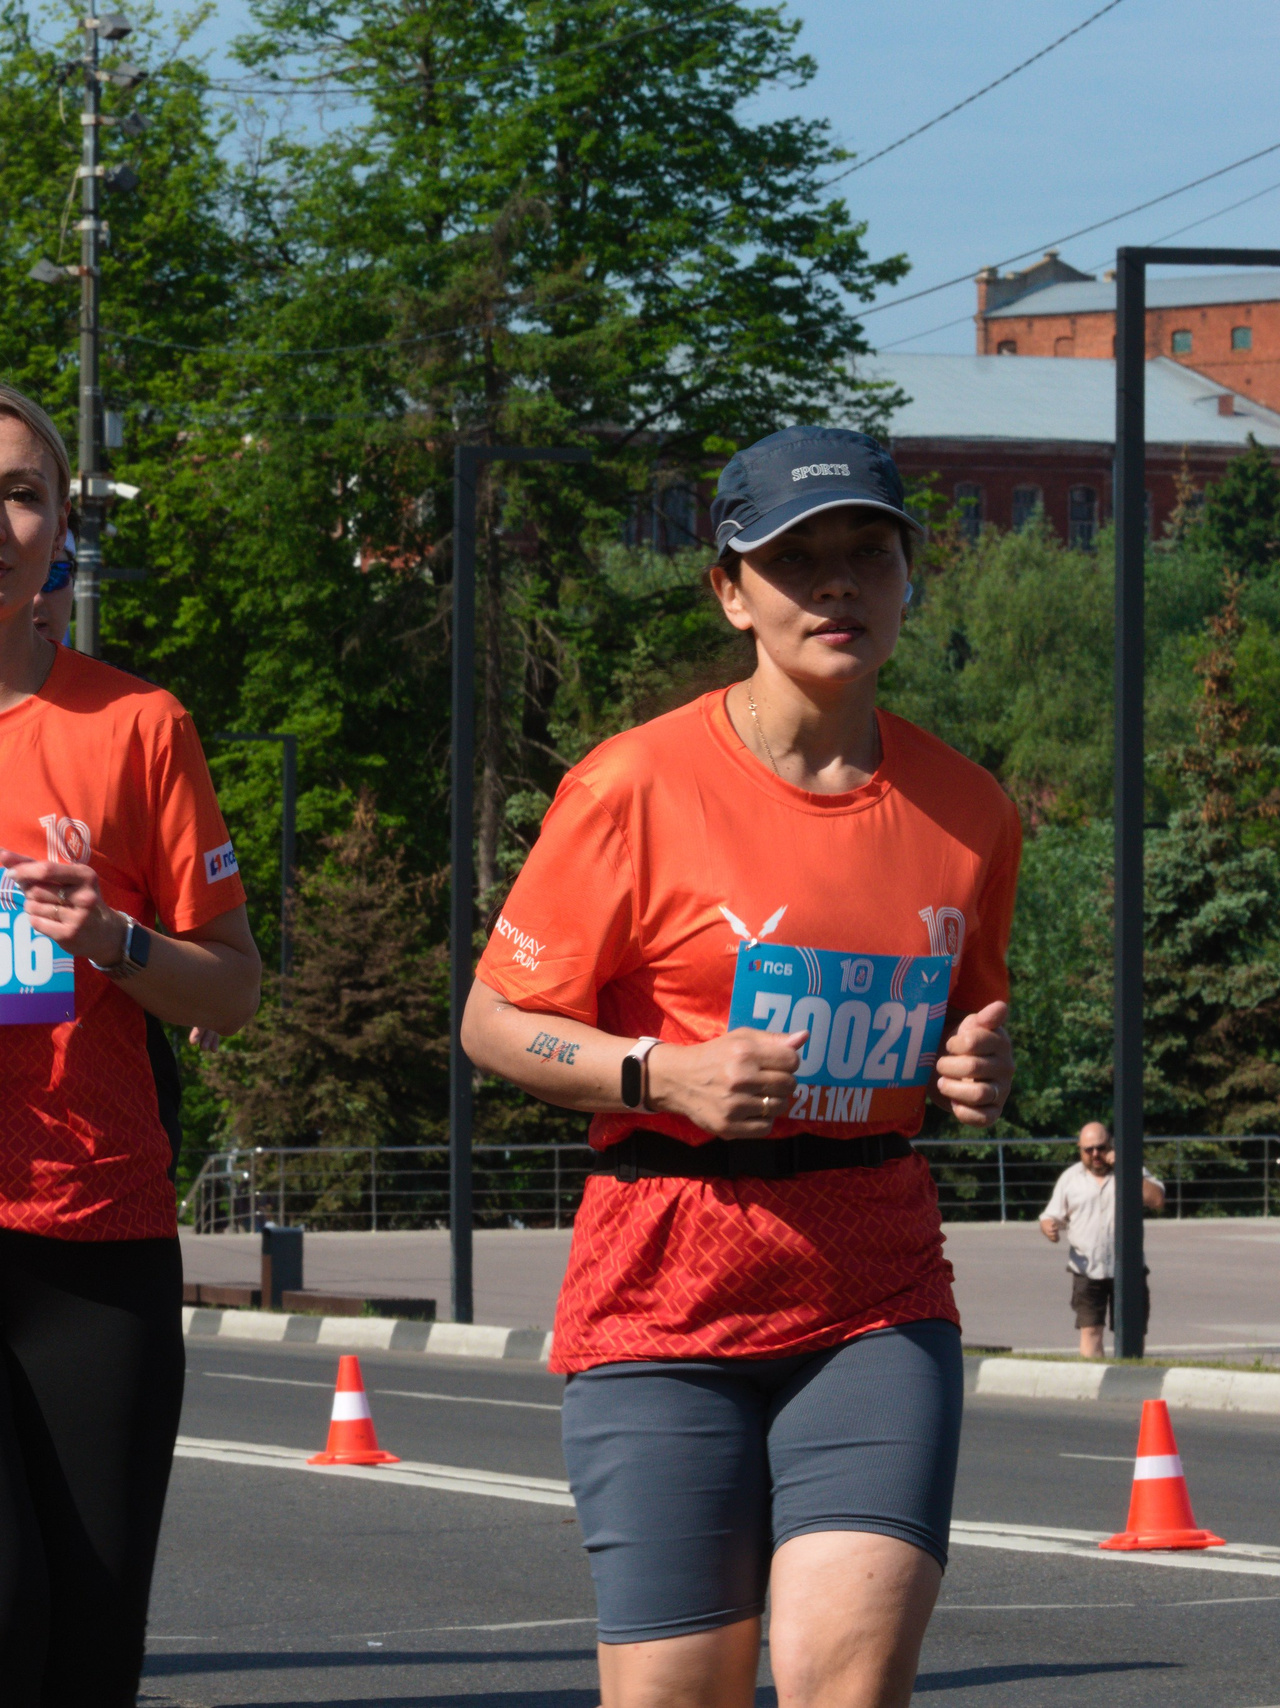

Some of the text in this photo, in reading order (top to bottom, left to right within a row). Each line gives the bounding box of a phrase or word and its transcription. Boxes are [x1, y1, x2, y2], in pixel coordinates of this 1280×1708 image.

[791, 463, 851, 482] SPORTS
[38, 812, 91, 864] 10
[512, 949, 540, 972] RUN
[763, 960, 793, 977] ПСБ
[840, 958, 875, 994] 10
[752, 991, 931, 1081] 70021
